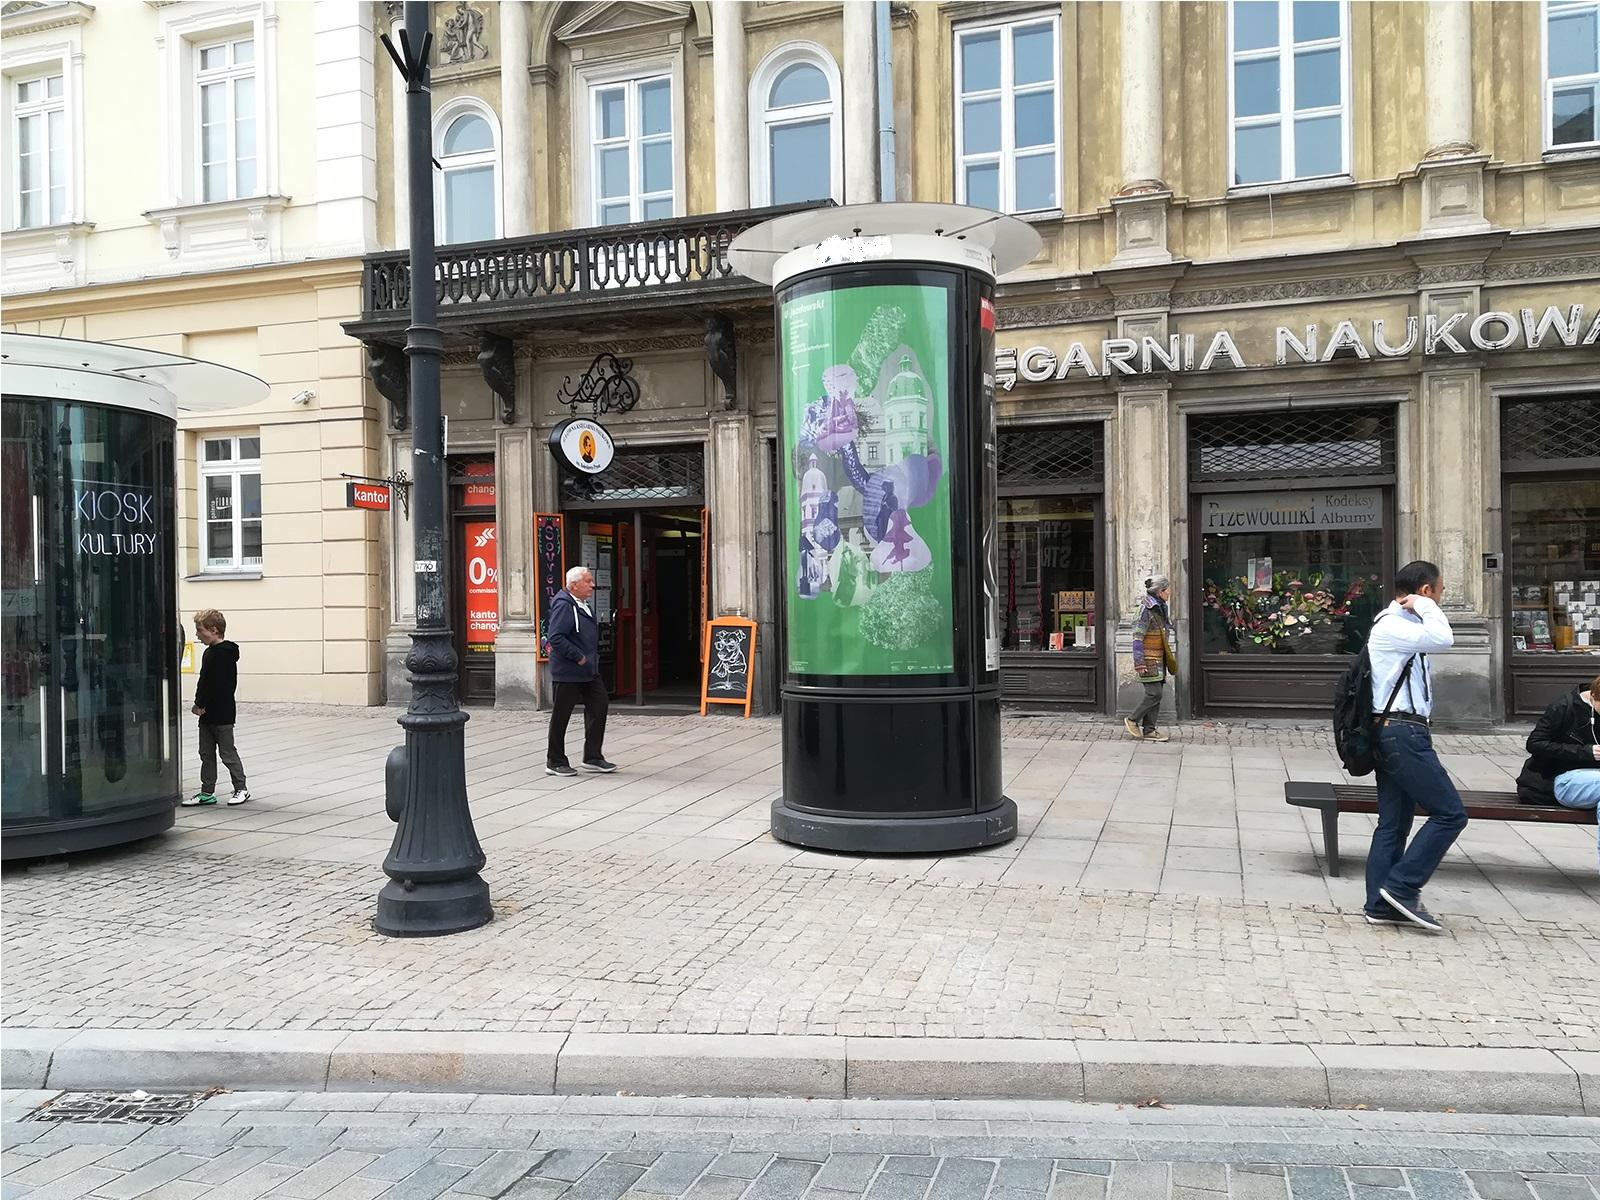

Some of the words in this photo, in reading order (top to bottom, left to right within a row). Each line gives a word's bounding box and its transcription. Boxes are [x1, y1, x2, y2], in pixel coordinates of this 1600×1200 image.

[995, 331, 1246, 392] ĘGARNIA
[354, 487, 389, 503] kantor
[467, 484, 496, 496] chang
[74, 490, 153, 523] KIOSK
[1326, 495, 1375, 510] Kodeksy
[1321, 512, 1376, 525] Albumy
[77, 533, 156, 555] KULTURY
[469, 557, 498, 585] 0%
[545, 526, 555, 599] Souven
[470, 610, 497, 619] kanto
